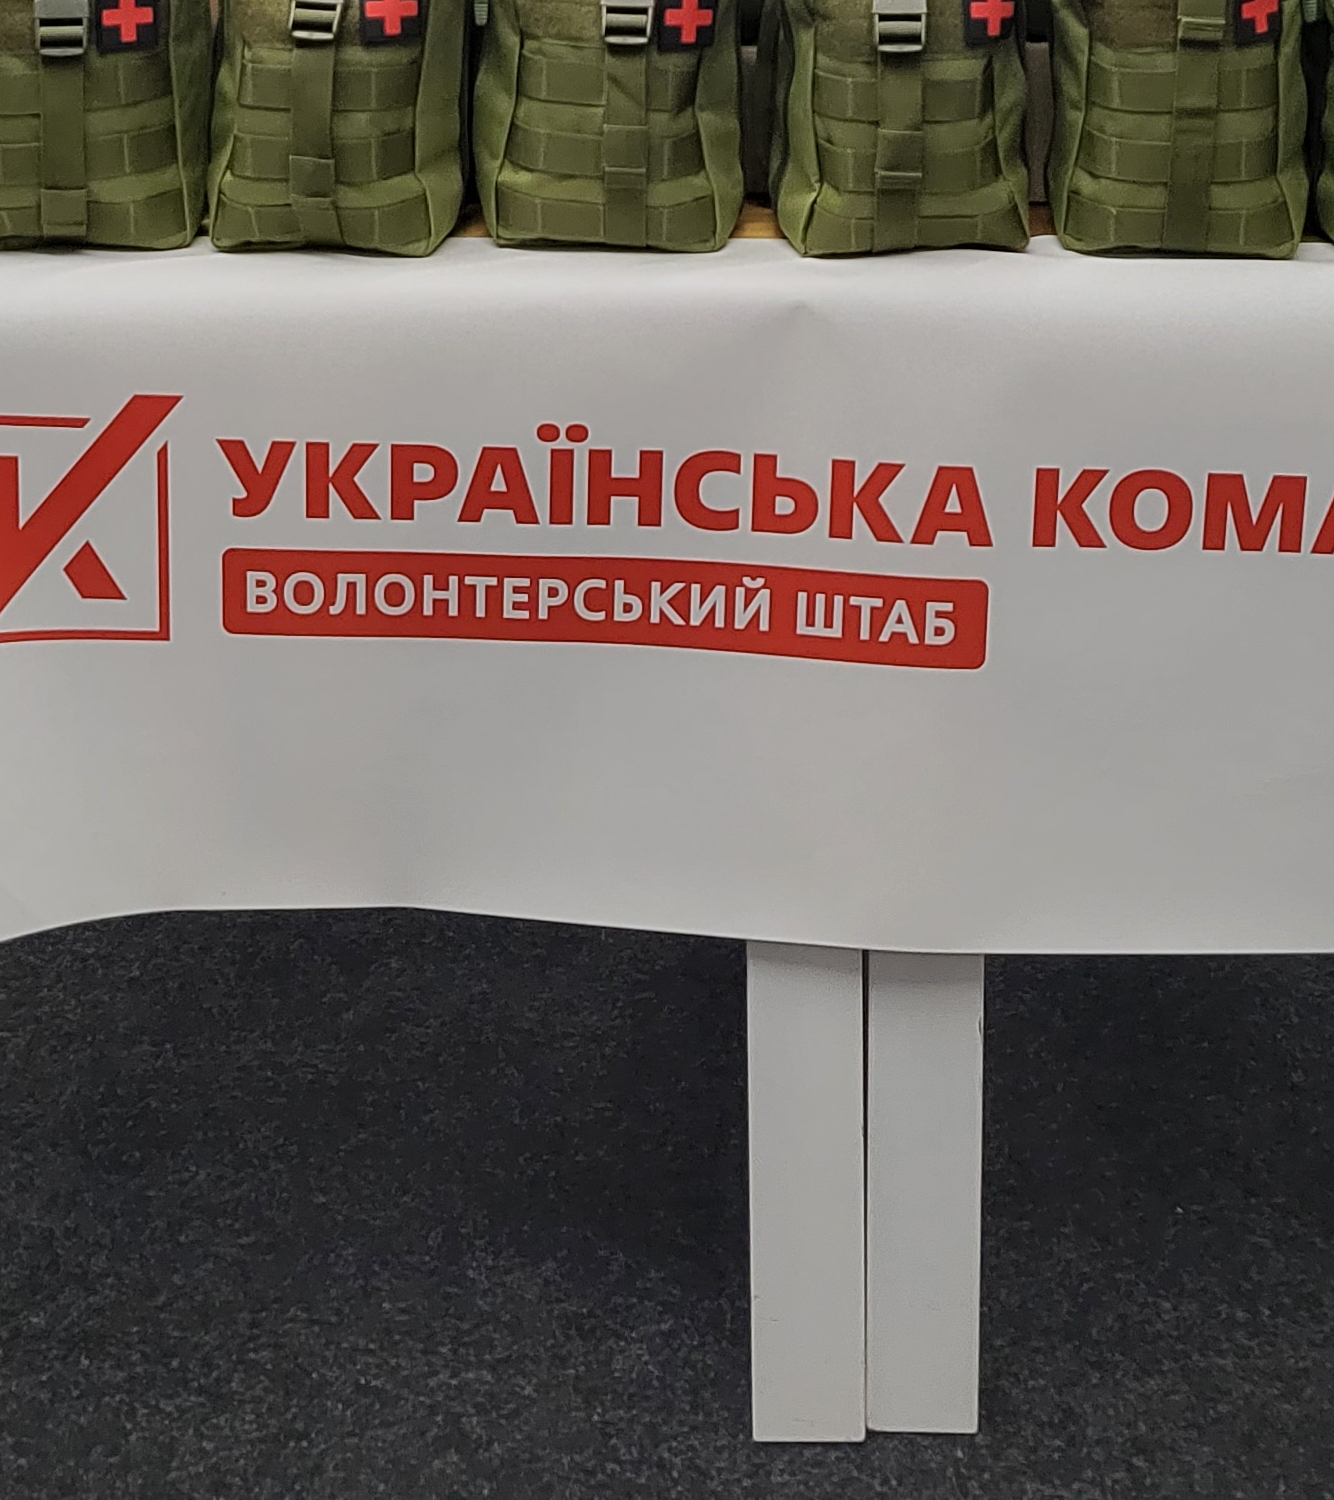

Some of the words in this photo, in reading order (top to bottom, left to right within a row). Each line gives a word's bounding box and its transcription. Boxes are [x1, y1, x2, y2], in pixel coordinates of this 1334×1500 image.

[217, 424, 992, 547] УКРАЇНСЬКА
[246, 570, 772, 632] ВОЛОНТЕРСЬКИЙ
[796, 591, 956, 646] ШТАБ
